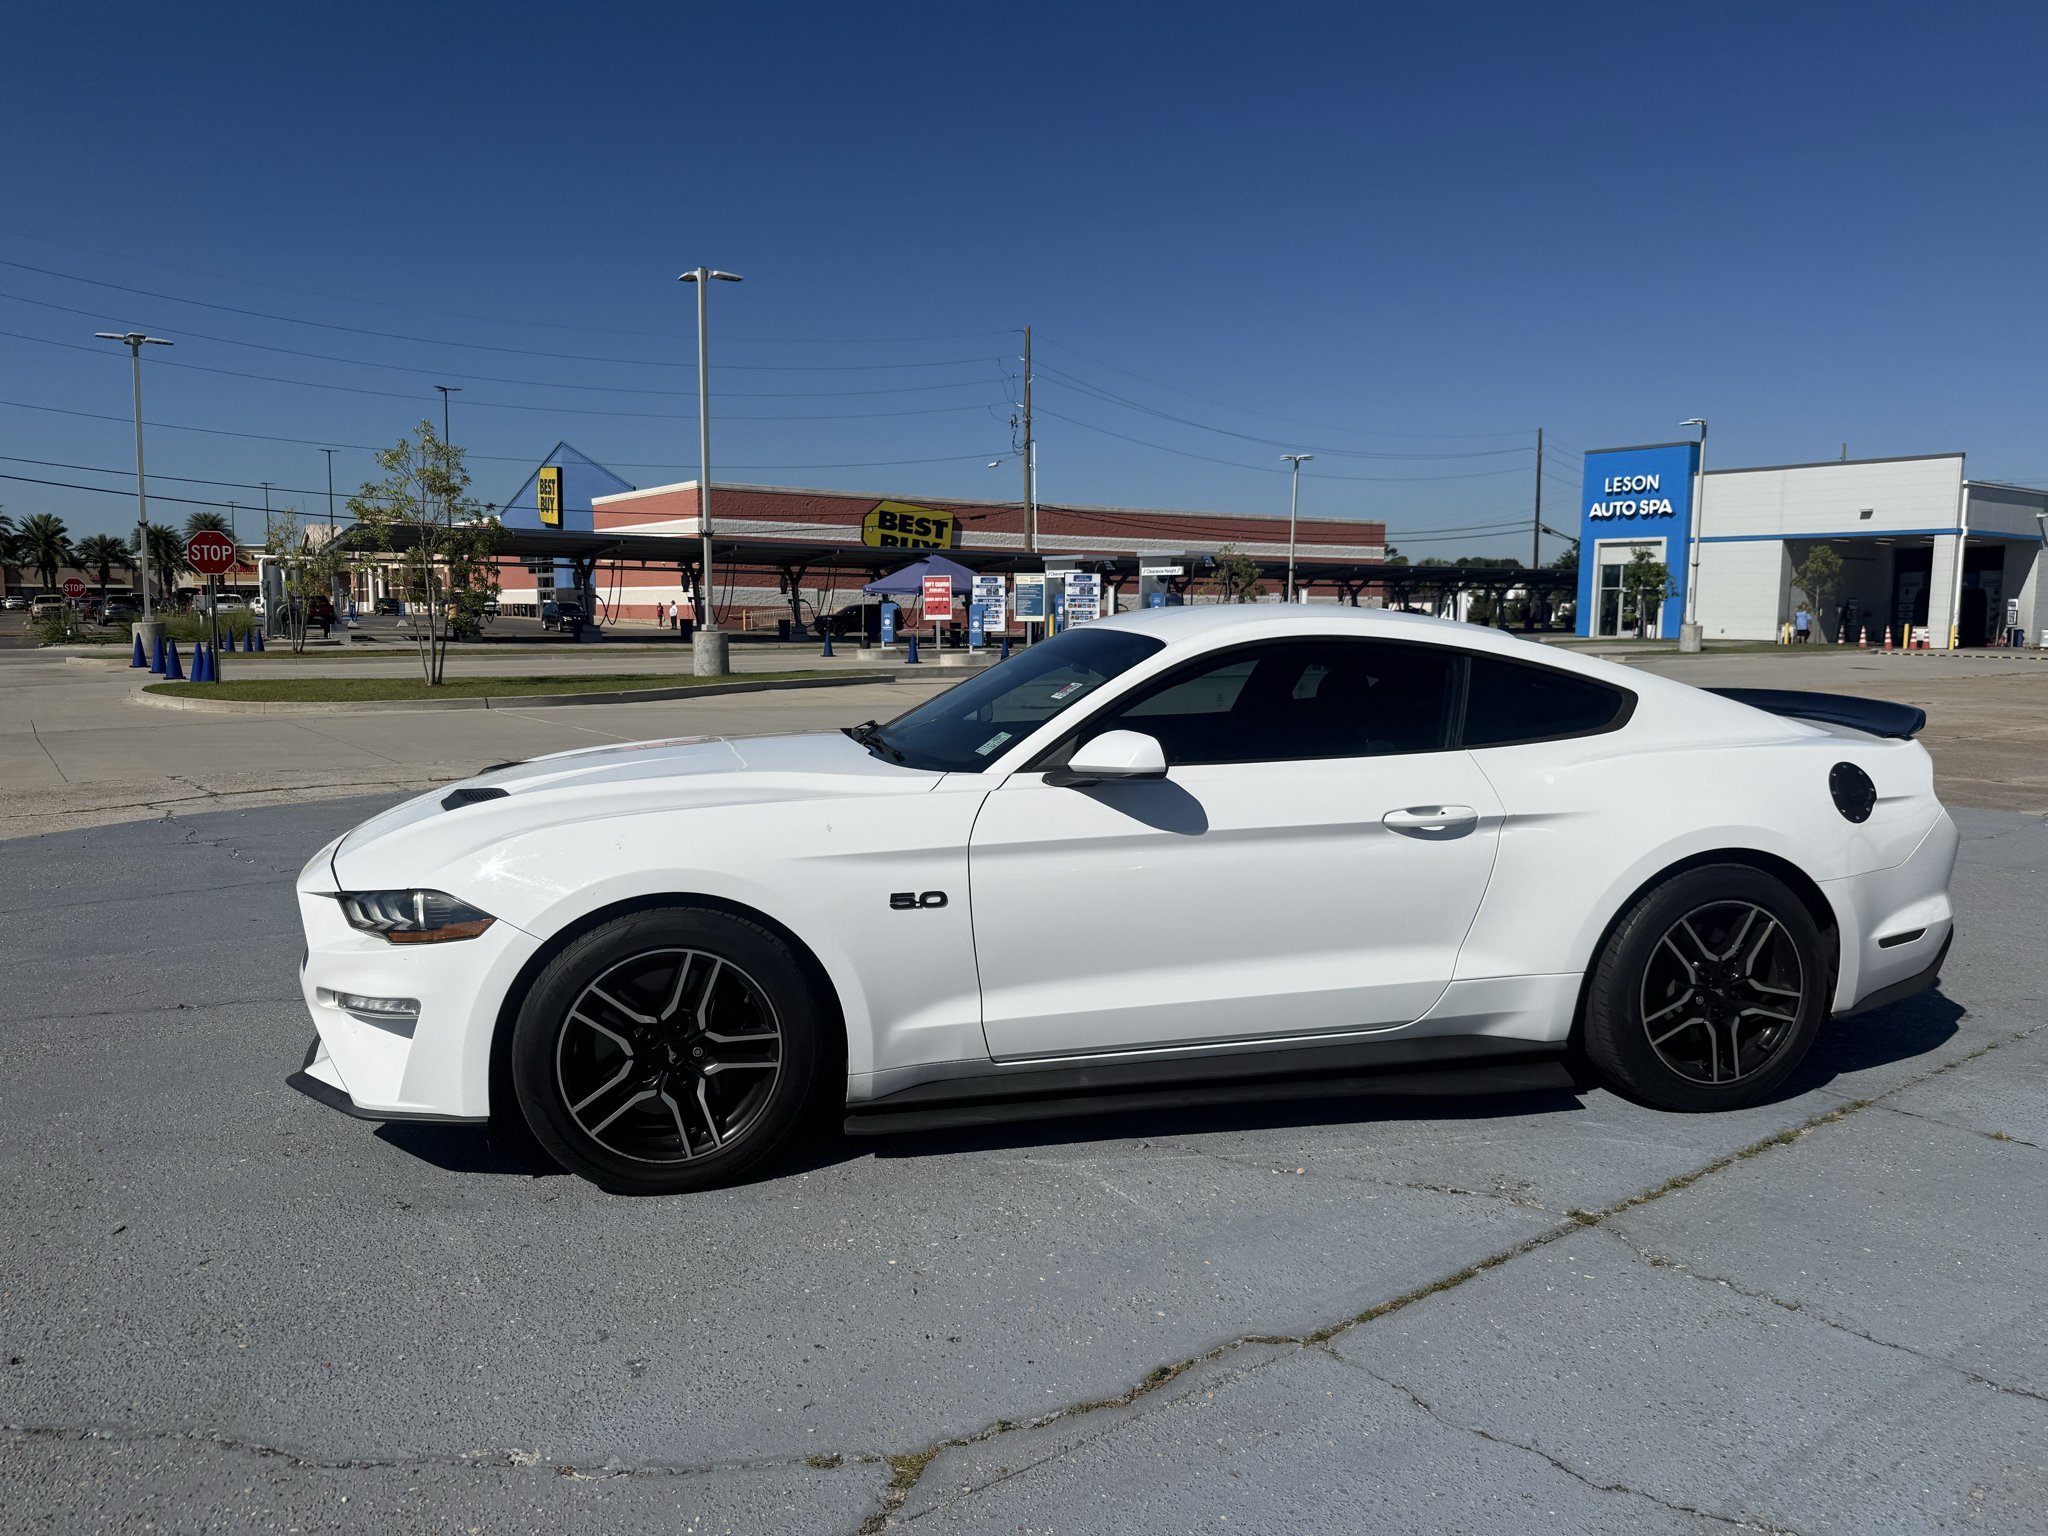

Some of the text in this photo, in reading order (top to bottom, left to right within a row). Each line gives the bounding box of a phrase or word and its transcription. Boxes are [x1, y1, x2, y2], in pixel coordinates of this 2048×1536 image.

[539, 478, 556, 496] BEST
[1604, 474, 1660, 493] LESON
[540, 496, 556, 514] BUY
[1589, 498, 1673, 518] AUTO SPA
[878, 510, 949, 540] BEST
[191, 544, 232, 561] STOP
[64, 583, 85, 592] STOP
[889, 890, 949, 911] 5.0
